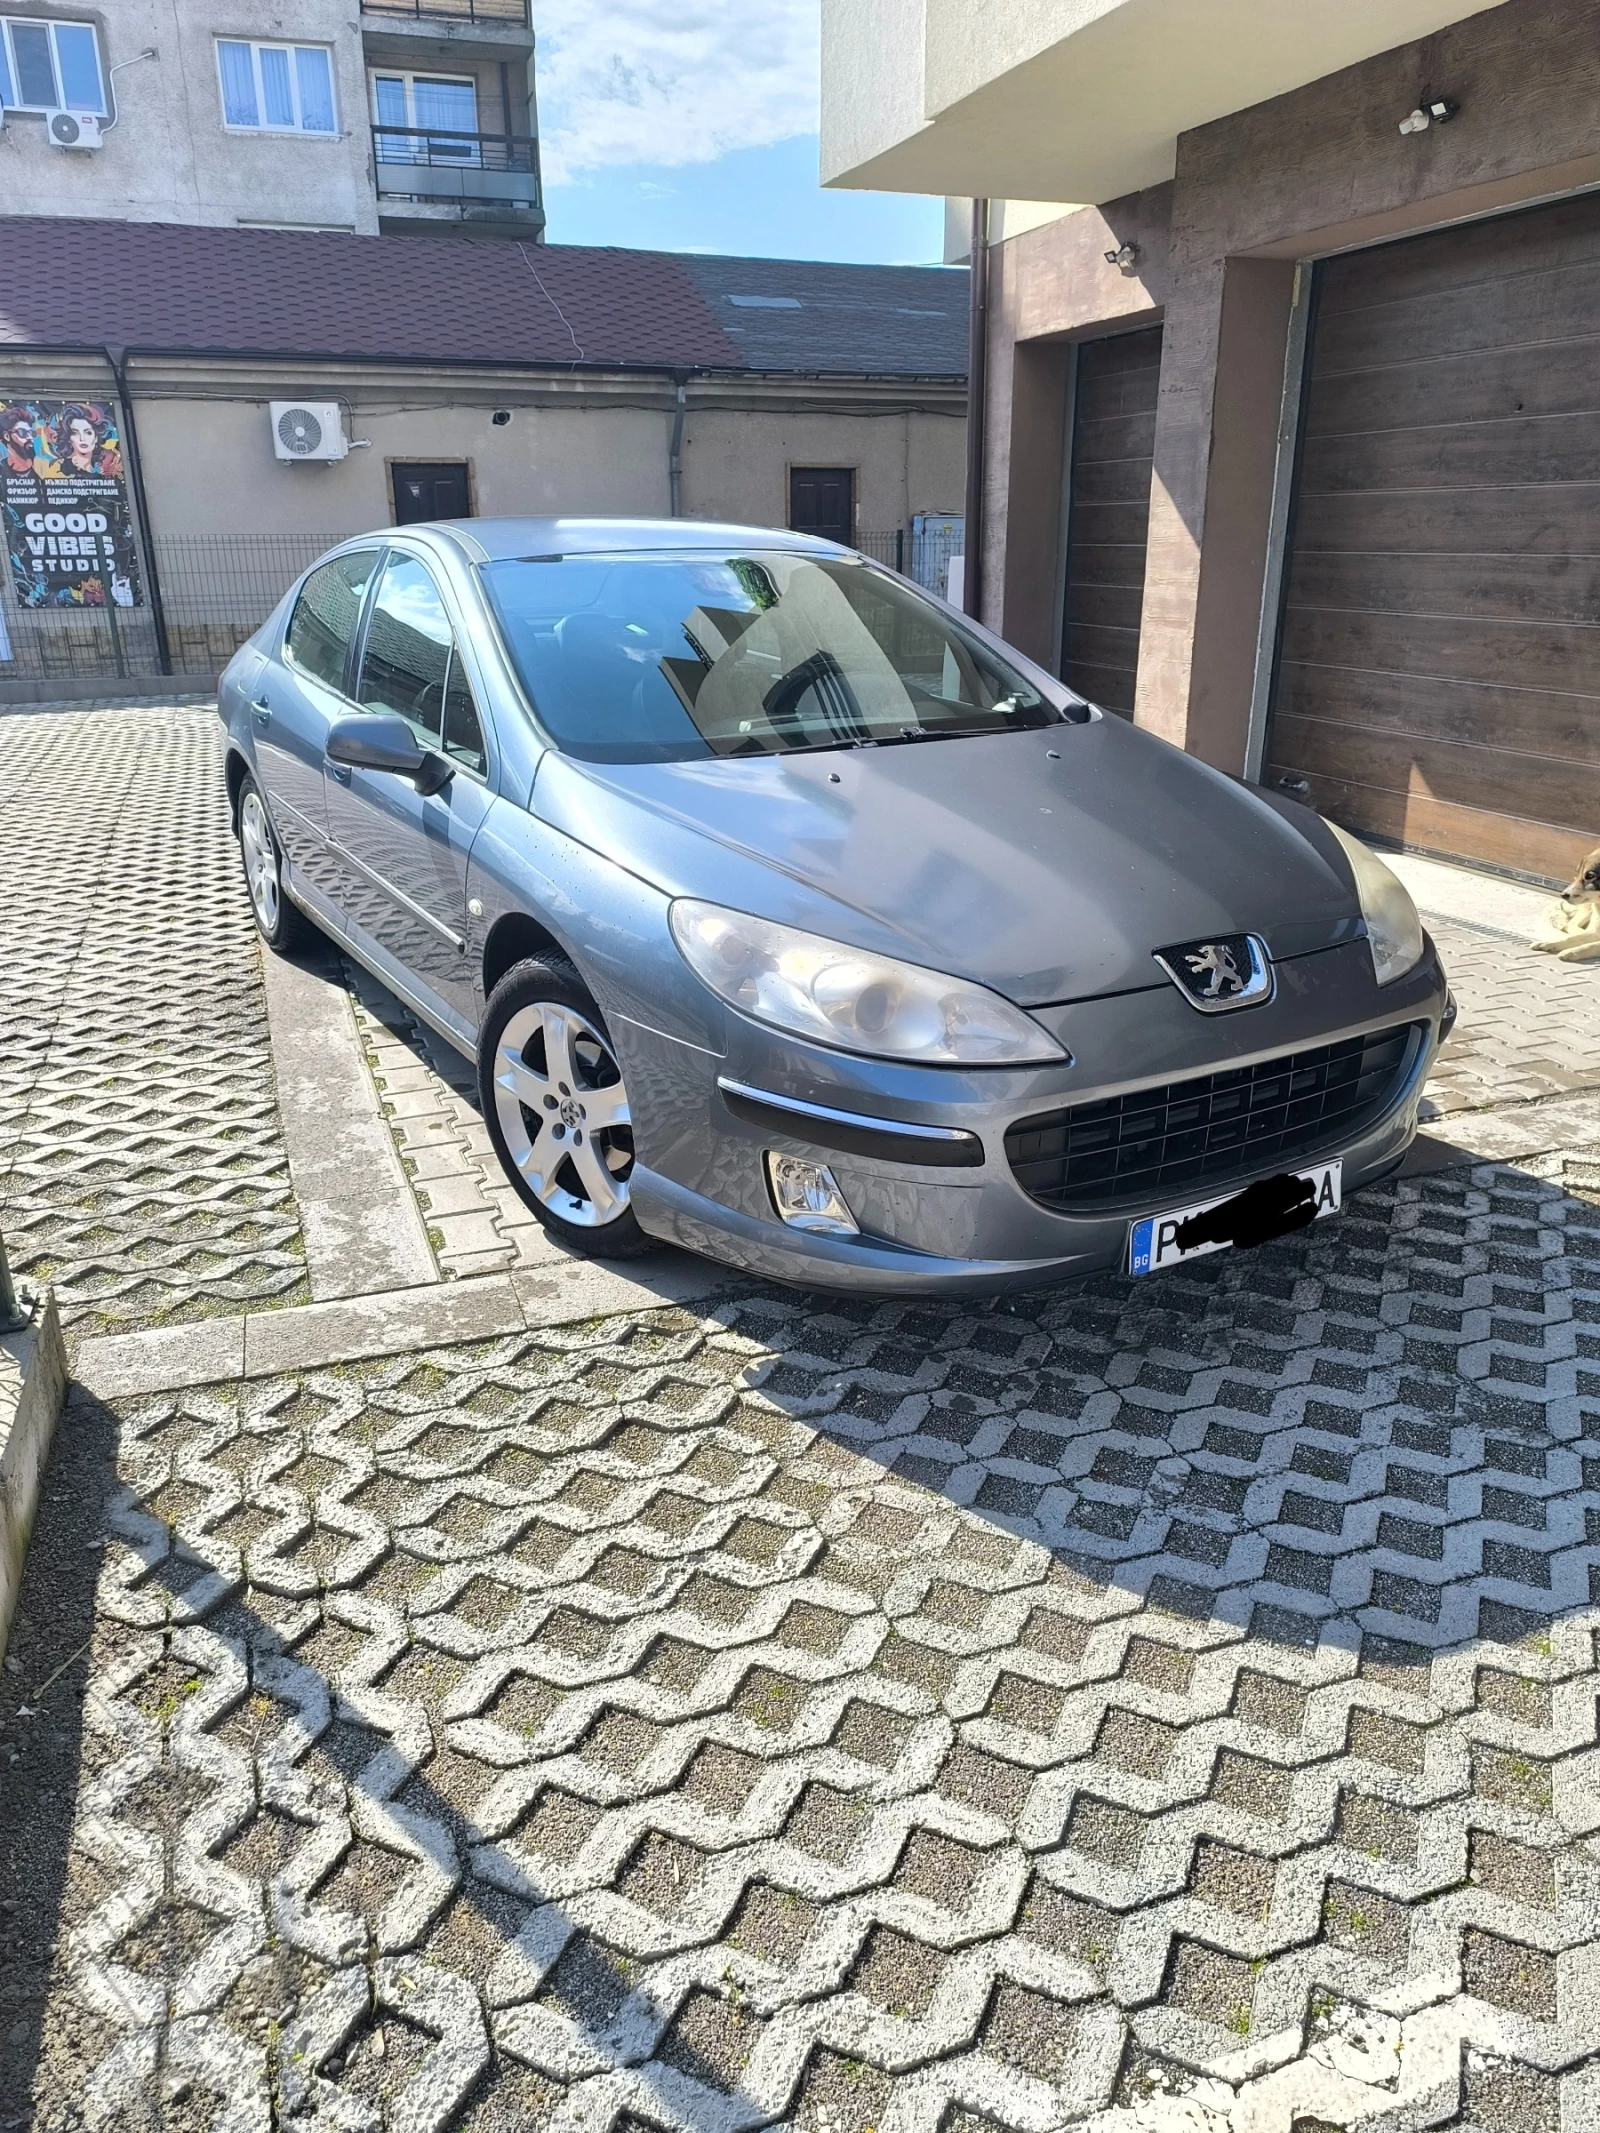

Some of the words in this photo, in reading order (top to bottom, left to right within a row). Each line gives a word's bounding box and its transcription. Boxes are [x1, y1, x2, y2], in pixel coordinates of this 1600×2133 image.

[69, 479, 116, 487] ПОДСТРИГВАНЕ
[46, 488, 72, 496] ДАМСКО
[73, 488, 119, 496] ПОДСТРИГВАНЕ
[48, 497, 78, 505] ПЕДИКЮР
[25, 513, 107, 533] GOOD
[25, 536, 115, 556] VIBES
[31, 559, 116, 572] STUDIO
[1134, 1253, 1149, 1269] BG
